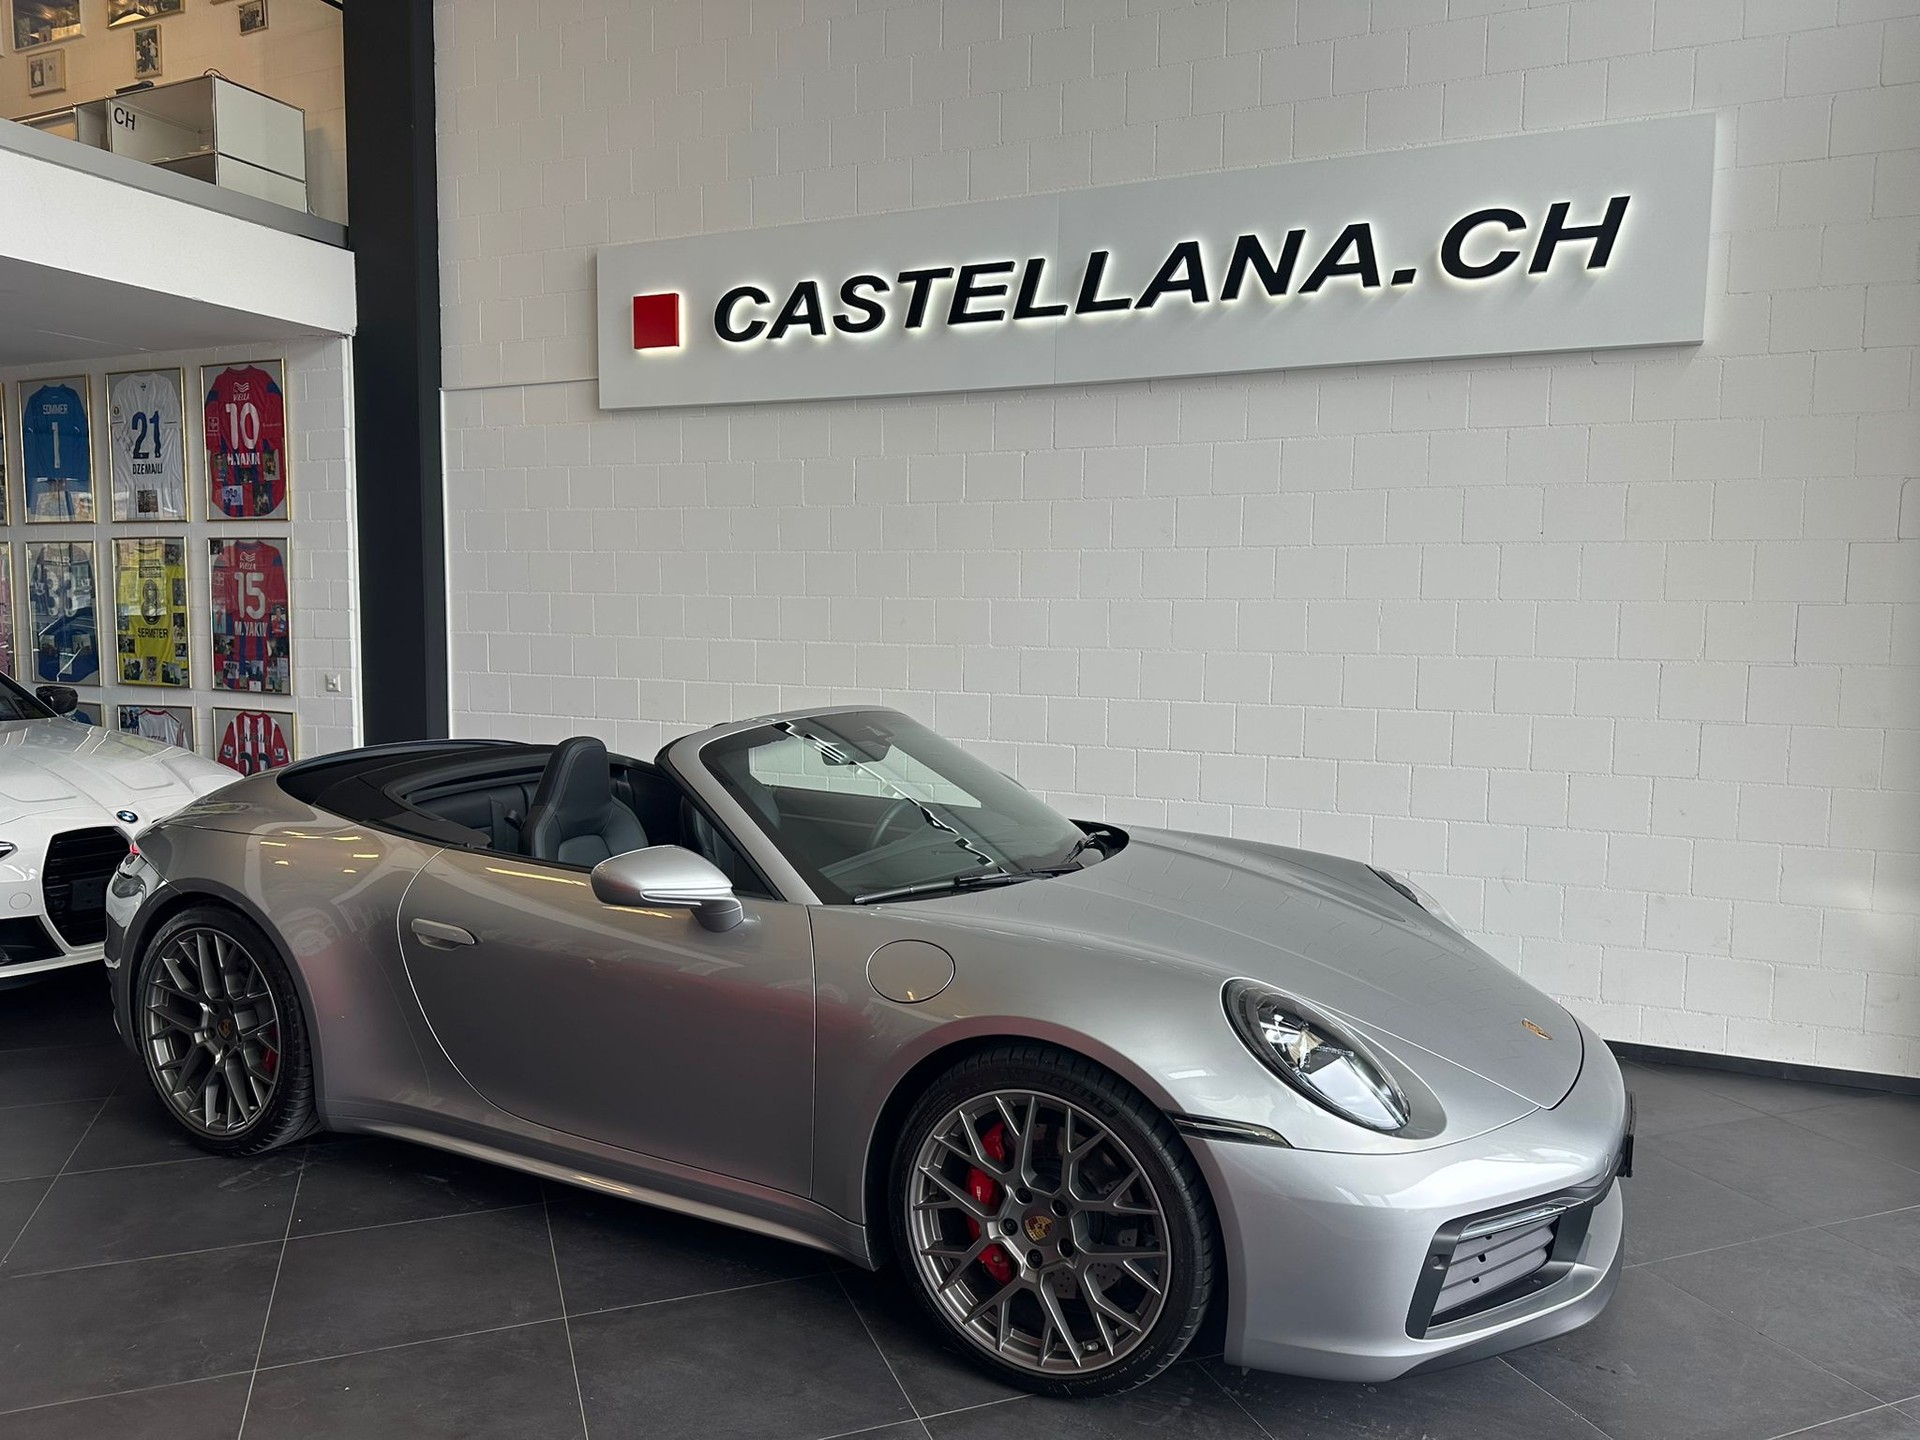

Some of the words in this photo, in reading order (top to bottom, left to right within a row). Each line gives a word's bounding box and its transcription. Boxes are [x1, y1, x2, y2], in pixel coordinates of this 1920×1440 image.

[114, 107, 135, 130] CH
[713, 195, 1632, 342] CASTELLANA.CH
[42, 403, 68, 415] SOMMER
[225, 402, 260, 450] 10
[51, 421, 60, 469] 1
[131, 411, 161, 459] 21
[132, 462, 163, 475] DZEMAILI
[234, 572, 266, 620] 15
[137, 627, 169, 639] SERMETER
